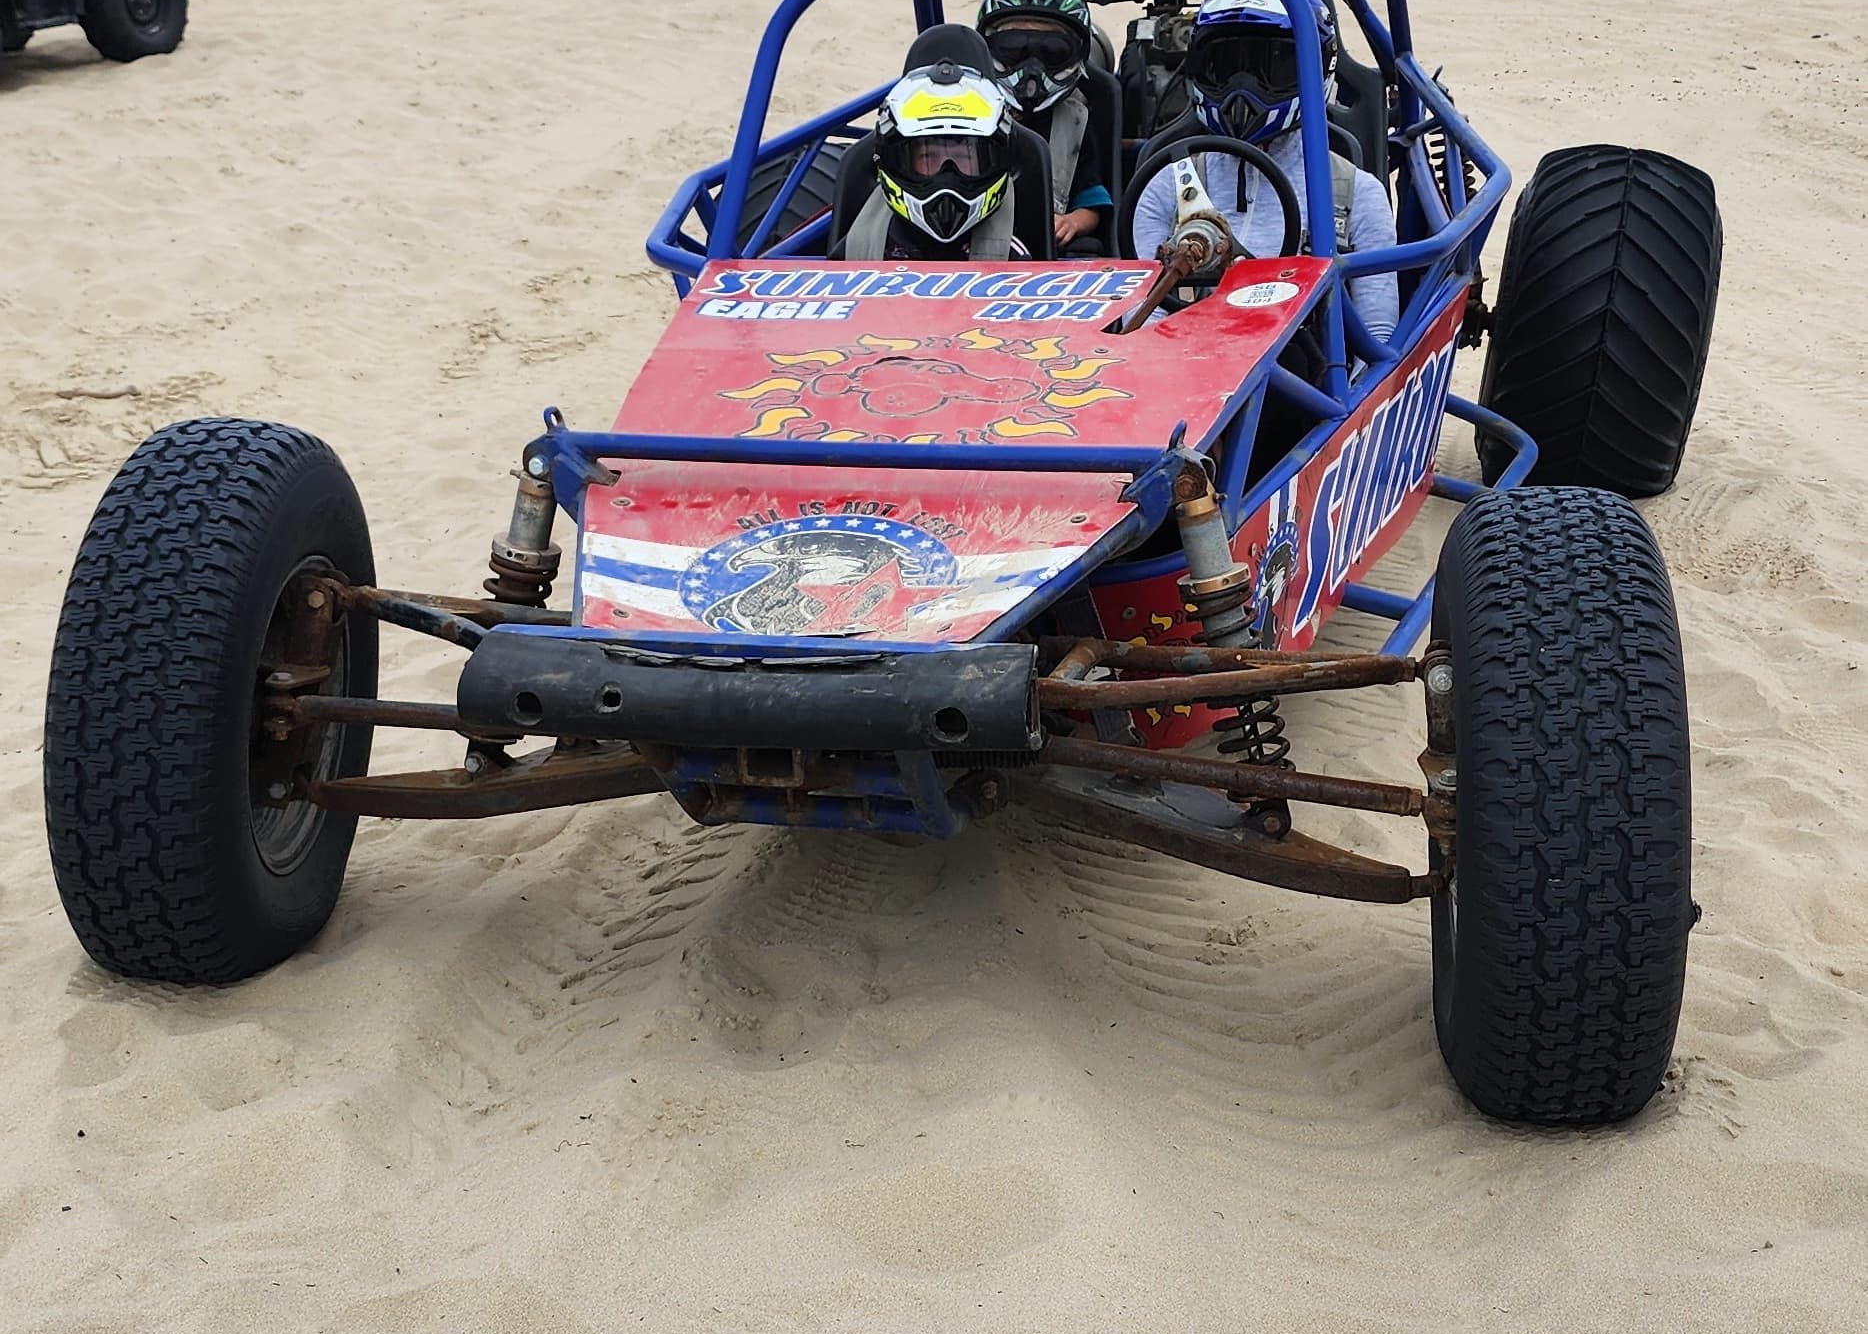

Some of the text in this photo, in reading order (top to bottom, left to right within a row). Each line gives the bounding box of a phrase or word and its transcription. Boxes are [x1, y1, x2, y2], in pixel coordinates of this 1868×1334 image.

[701, 269, 1153, 298] SUNBUGGIE
[697, 298, 1112, 321] EAGLE 404
[735, 508, 782, 530] ALL
[798, 501, 826, 517] IS
[840, 501, 899, 517] NOT
